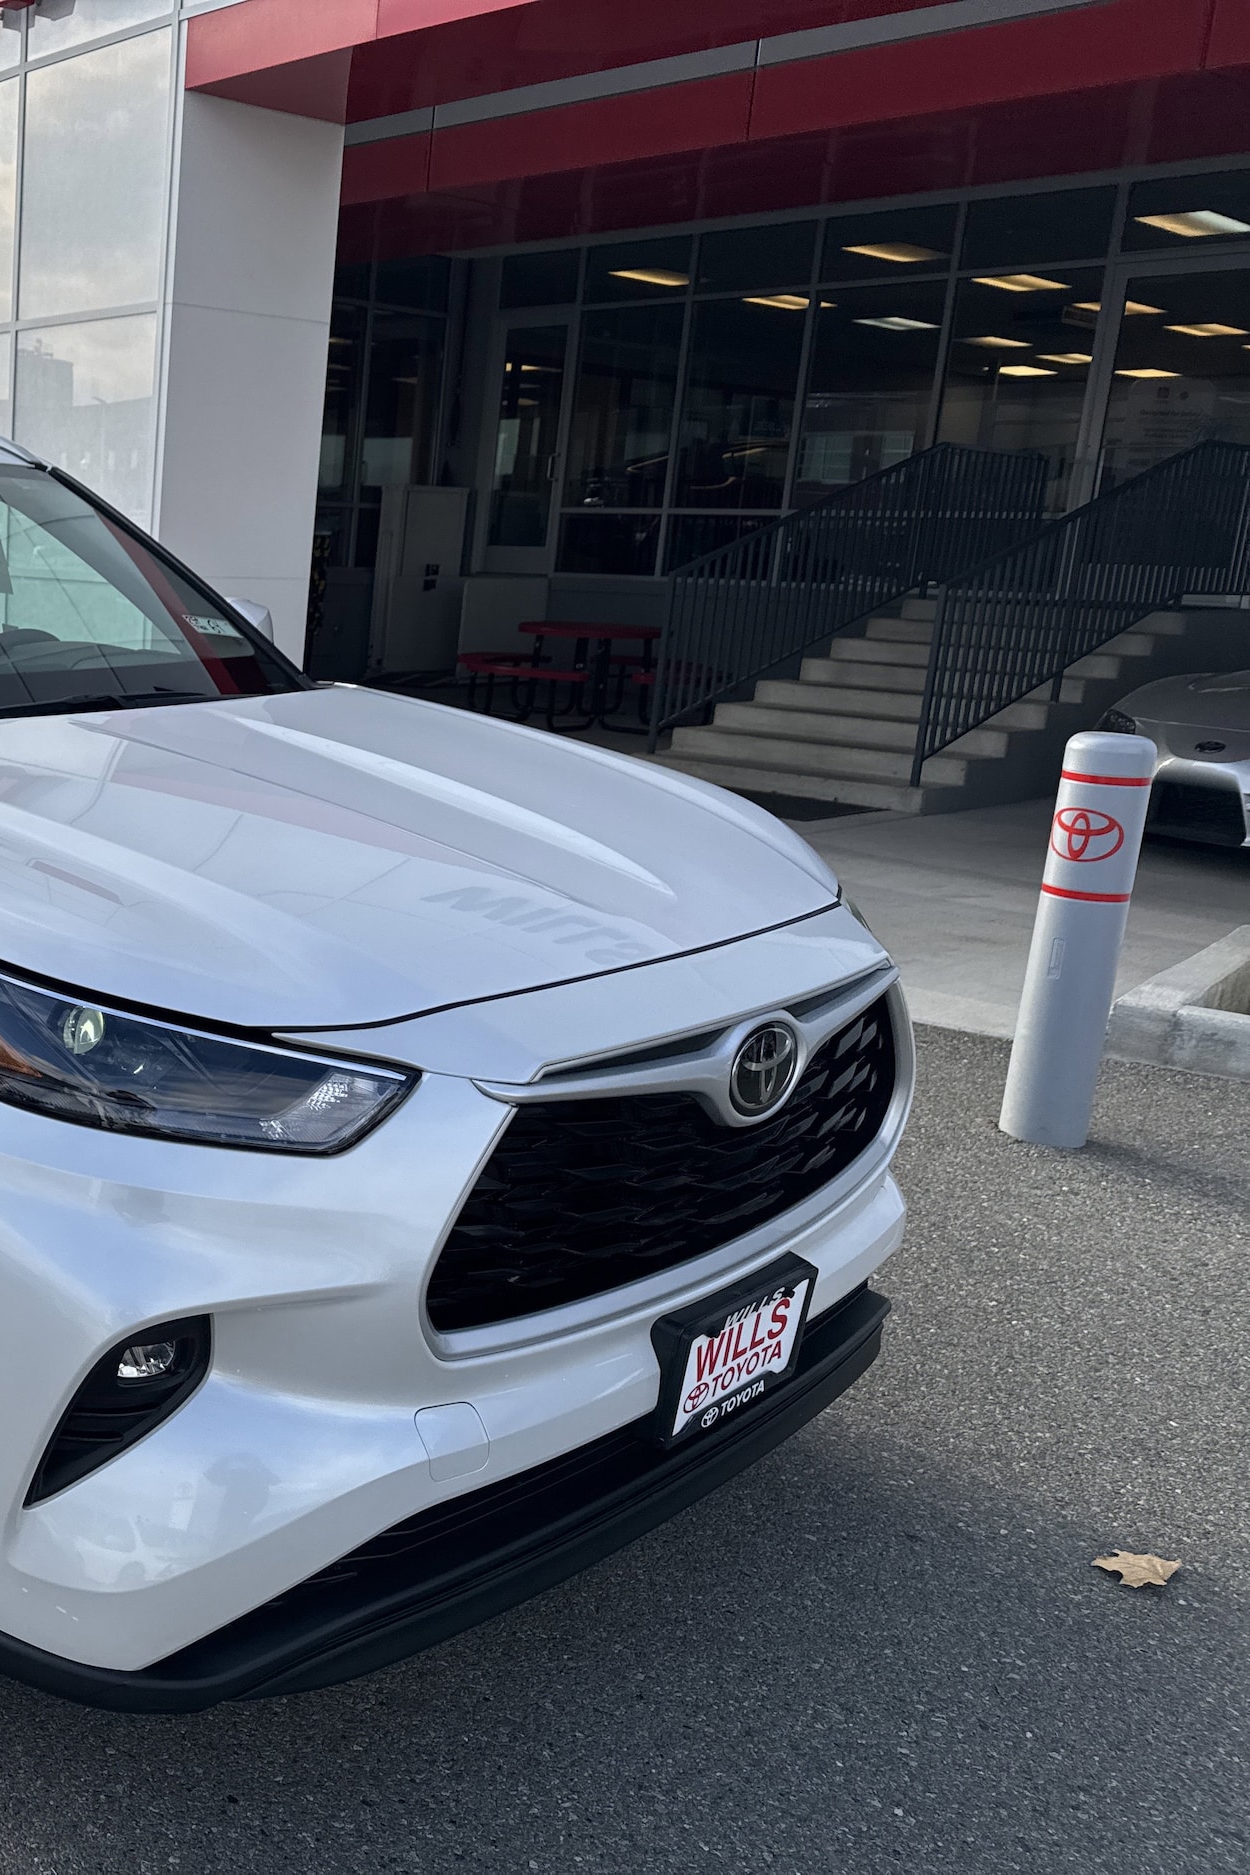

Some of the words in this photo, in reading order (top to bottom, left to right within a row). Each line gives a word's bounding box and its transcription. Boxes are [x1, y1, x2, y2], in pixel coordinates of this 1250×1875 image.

[696, 1297, 791, 1383] WILLS
[712, 1340, 782, 1397] TOYOTA
[720, 1379, 765, 1417] TOYOTA
